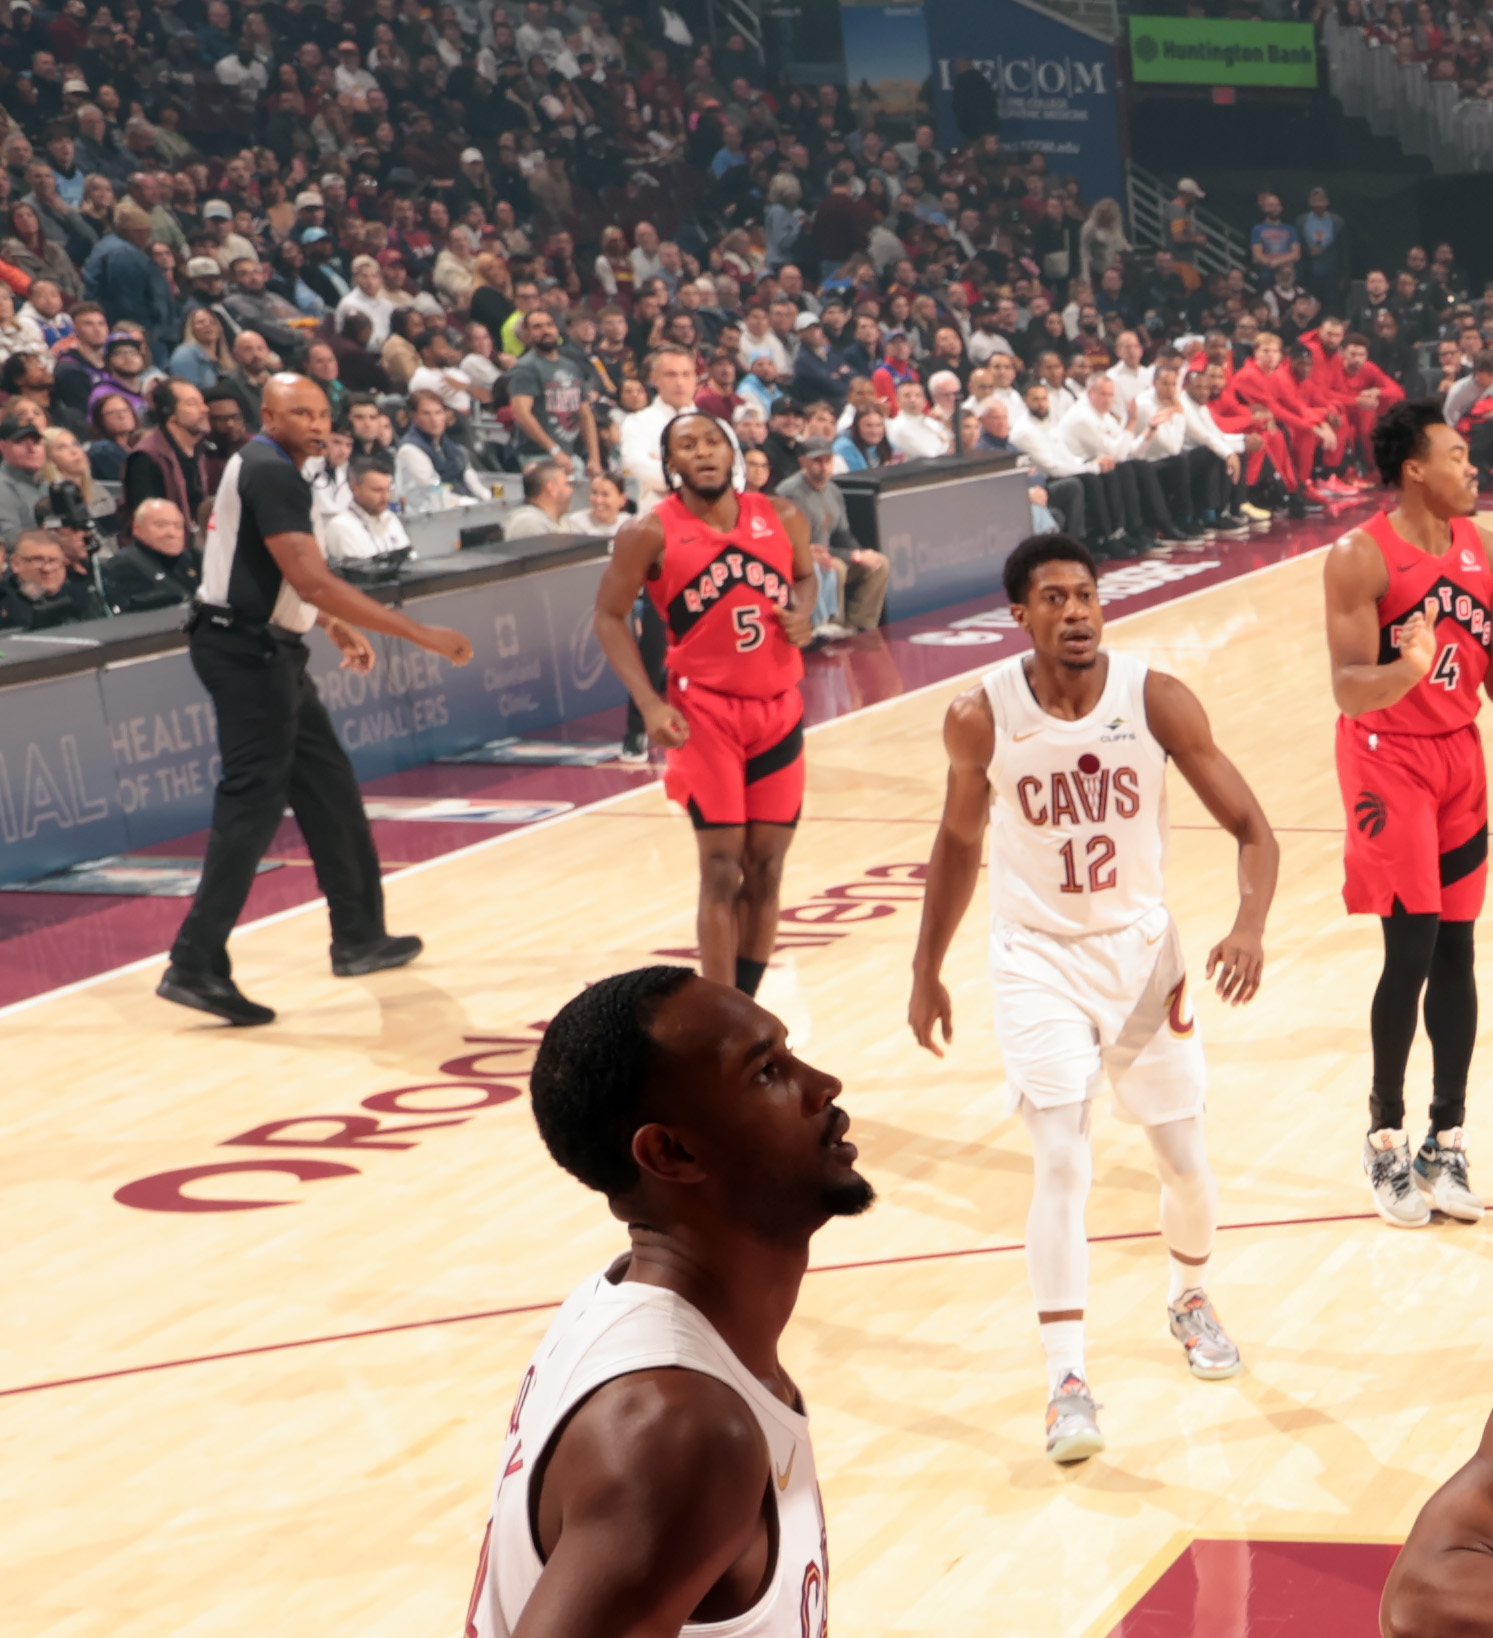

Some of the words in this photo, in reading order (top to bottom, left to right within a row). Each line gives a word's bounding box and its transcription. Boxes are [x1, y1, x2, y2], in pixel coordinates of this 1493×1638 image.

[1162, 40, 1265, 67] Huntington
[1267, 43, 1312, 64] Bank
[731, 604, 765, 653] 5
[1430, 643, 1460, 690] 4
[156, 759, 205, 804] THE
[1017, 765, 1140, 826] CAVS
[1060, 834, 1117, 893] 12
